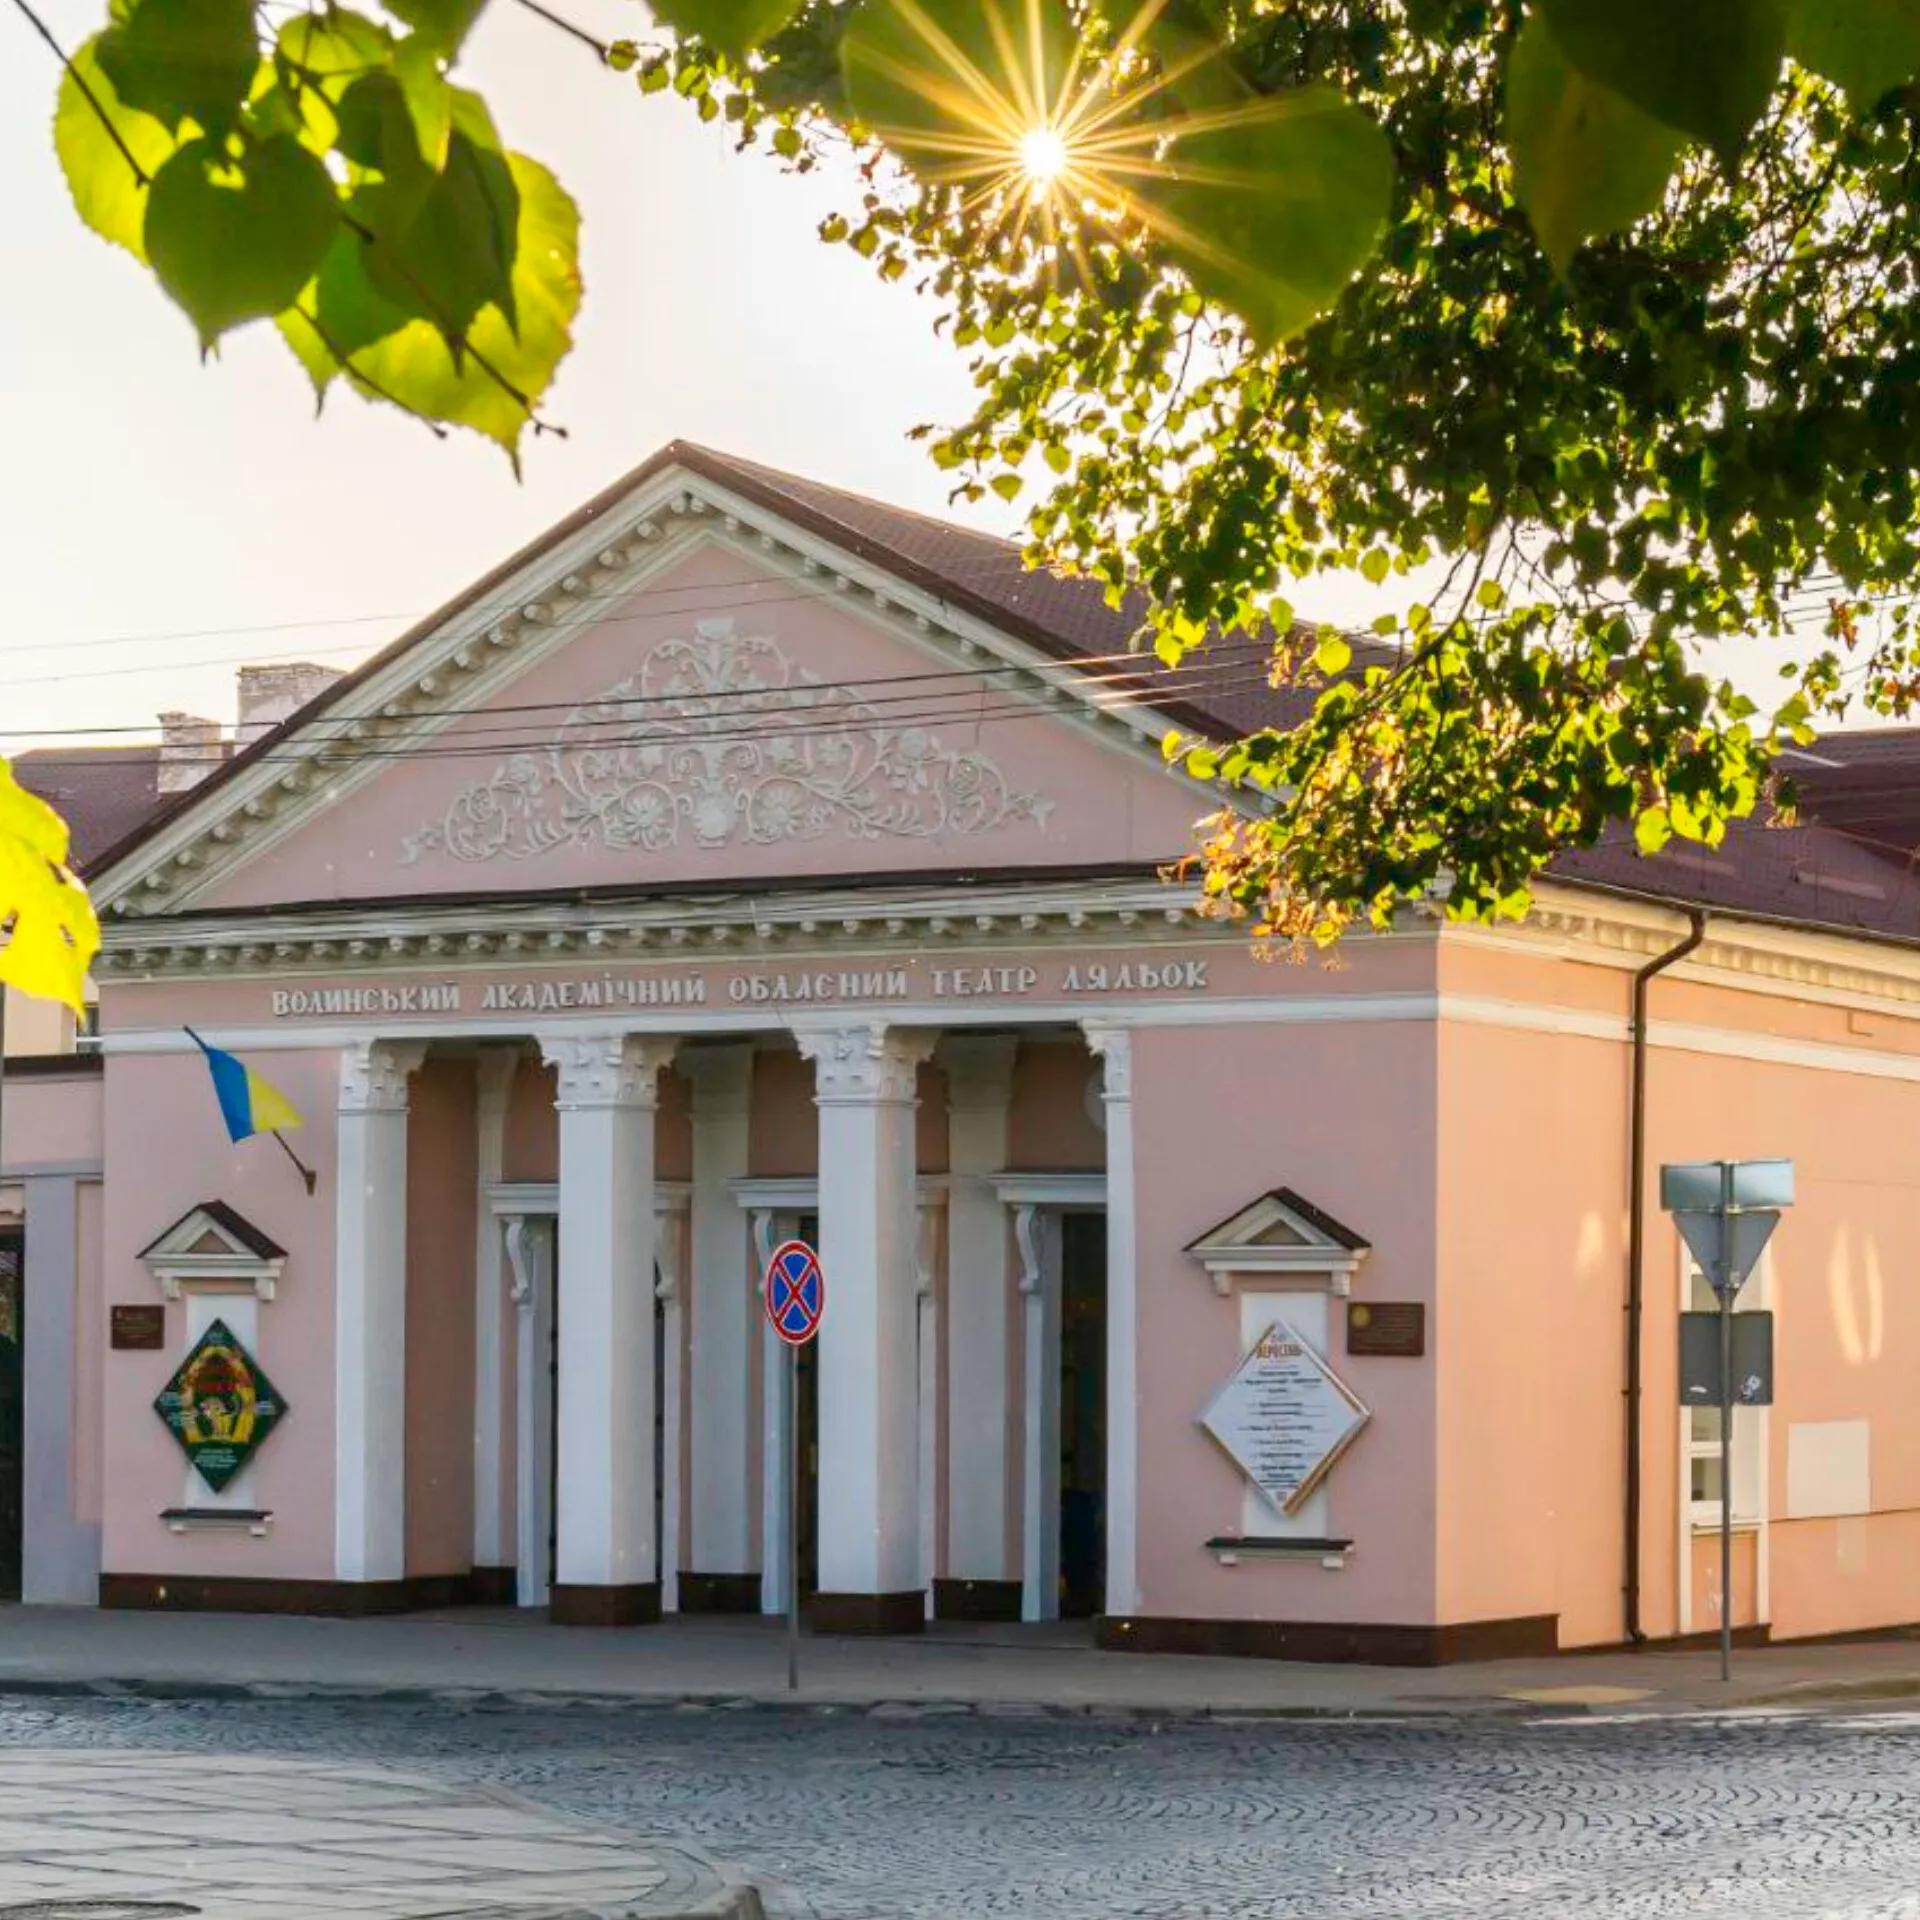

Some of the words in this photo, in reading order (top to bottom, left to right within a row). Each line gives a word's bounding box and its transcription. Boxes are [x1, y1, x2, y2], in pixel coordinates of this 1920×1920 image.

[272, 980, 461, 1016] ВОЛИНСЬКИЙ
[481, 971, 706, 1010] АКАДЕМІЧНИЙ
[729, 964, 908, 1001] ОБЛАСНИЙ
[929, 966, 1037, 996] ТЕАТР
[1062, 960, 1208, 991] ЛЯЛЬОК
